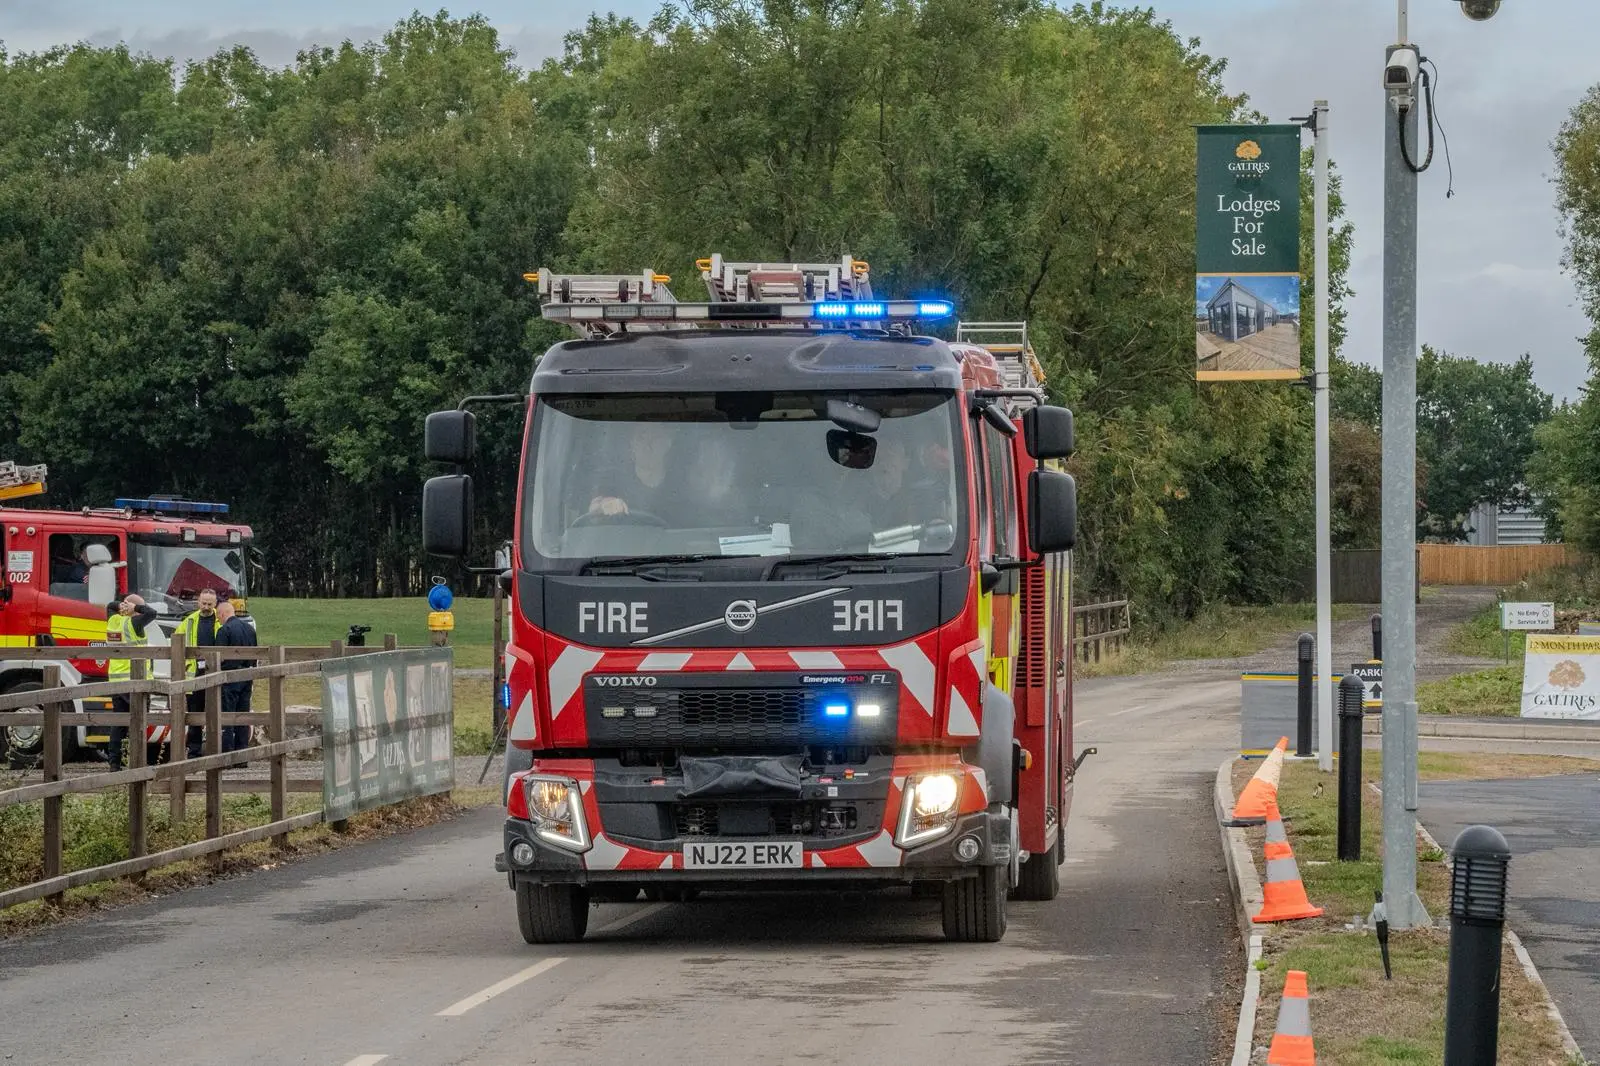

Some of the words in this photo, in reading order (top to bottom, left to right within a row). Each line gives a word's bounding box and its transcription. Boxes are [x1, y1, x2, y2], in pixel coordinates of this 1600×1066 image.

[1228, 162, 1270, 173] GALTRES
[1217, 193, 1281, 218] Lodges
[1233, 216, 1265, 234] For
[1231, 238, 1266, 255] Sale
[9, 572, 31, 583] 002
[578, 601, 648, 633] FIRE
[1529, 641, 1539, 649] 12
[1540, 641, 1580, 650] MONTH
[593, 676, 657, 687] VOLVO
[870, 674, 892, 684] FL
[1534, 694, 1596, 711] GALTRES
[692, 845, 747, 865] NJ22
[753, 845, 794, 865] ERK
